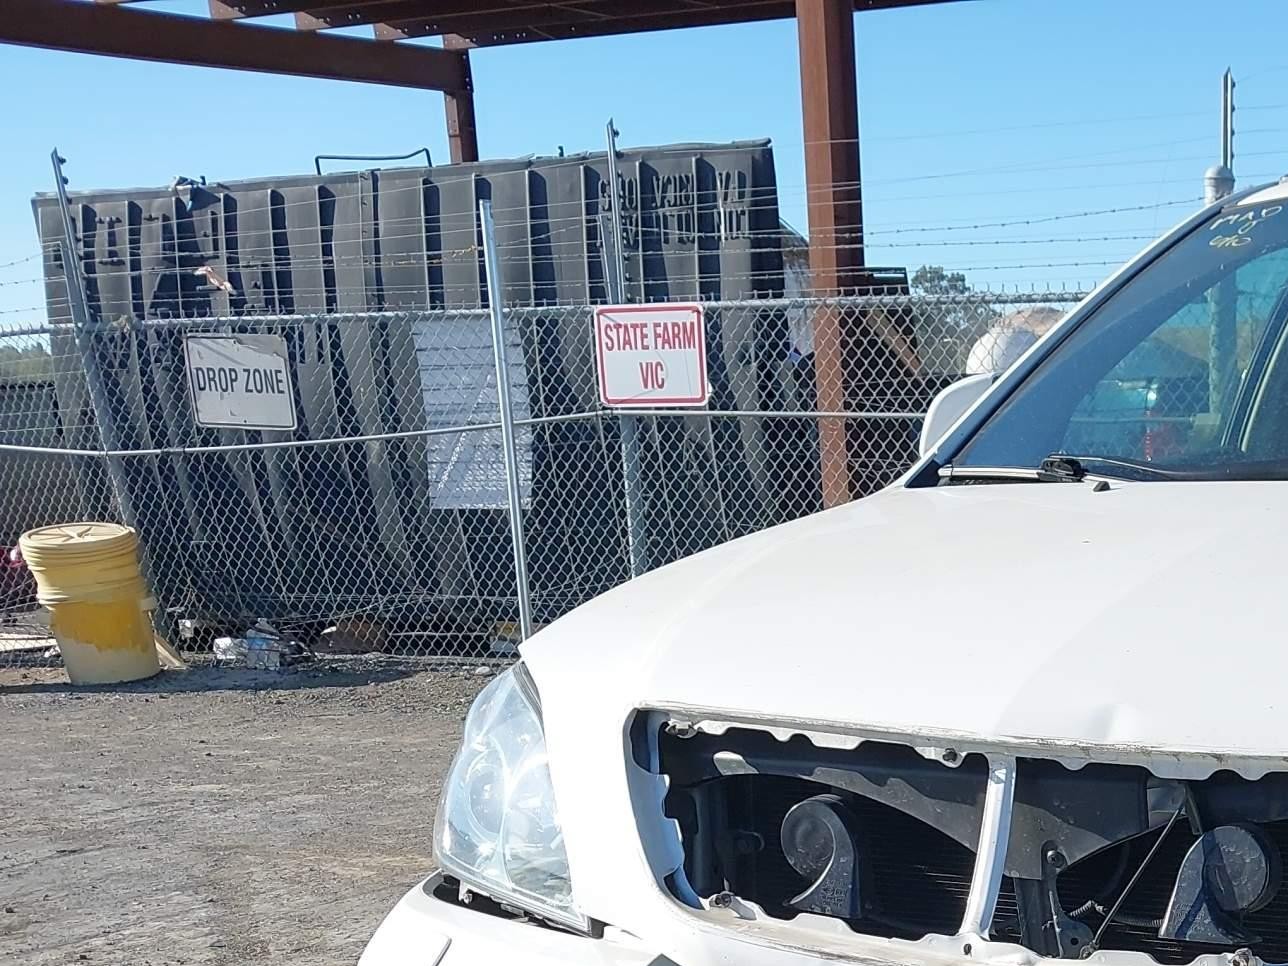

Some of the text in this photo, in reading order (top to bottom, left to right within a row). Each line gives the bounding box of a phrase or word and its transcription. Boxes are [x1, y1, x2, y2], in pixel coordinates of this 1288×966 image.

[604, 320, 697, 352] STATE FARM
[193, 366, 286, 395] DROP ZONE
[639, 361, 666, 390] VIC
